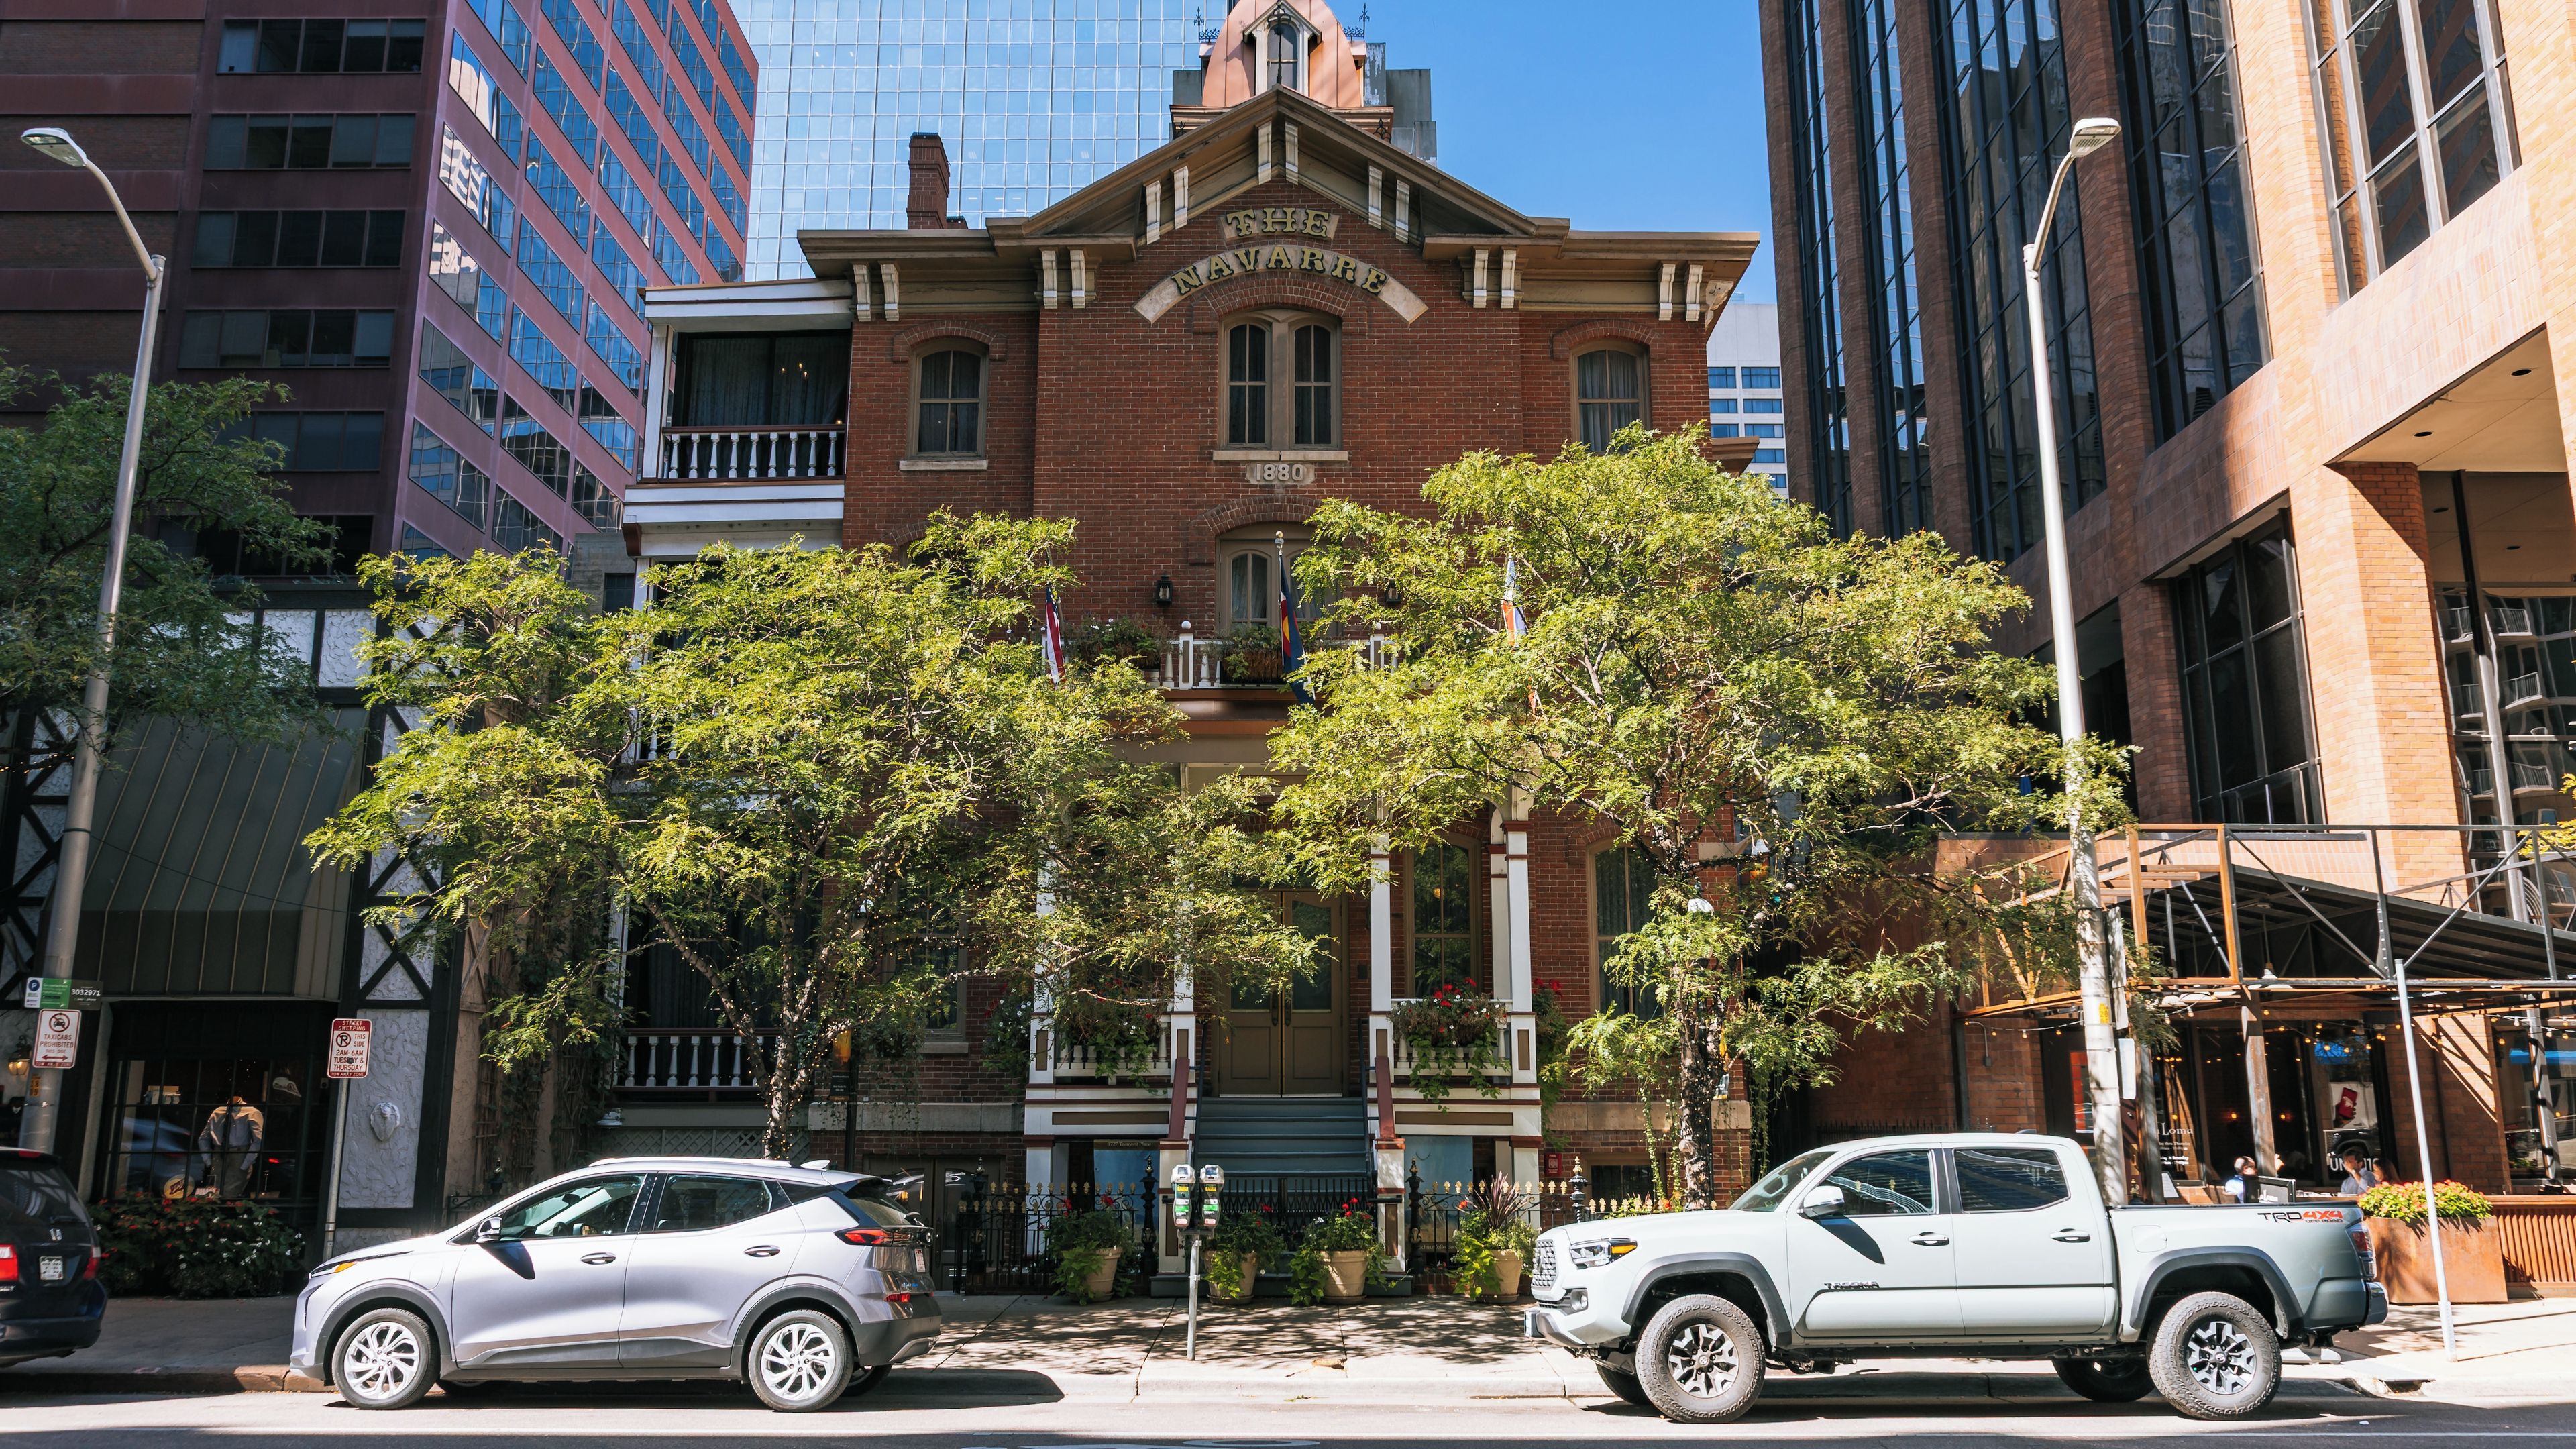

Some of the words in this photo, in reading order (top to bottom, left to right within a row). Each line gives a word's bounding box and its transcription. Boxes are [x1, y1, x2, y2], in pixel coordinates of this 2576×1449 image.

[1226, 207, 1330, 237] THE
[1171, 246, 1387, 296] NAVARRE
[1256, 463, 1304, 482] 1880
[2161, 1122, 2194, 1135] Loma
[2257, 1212, 2302, 1223] TRD
[2303, 1211, 2343, 1219] 4X4
[1824, 1281, 1880, 1289] TACOMA
